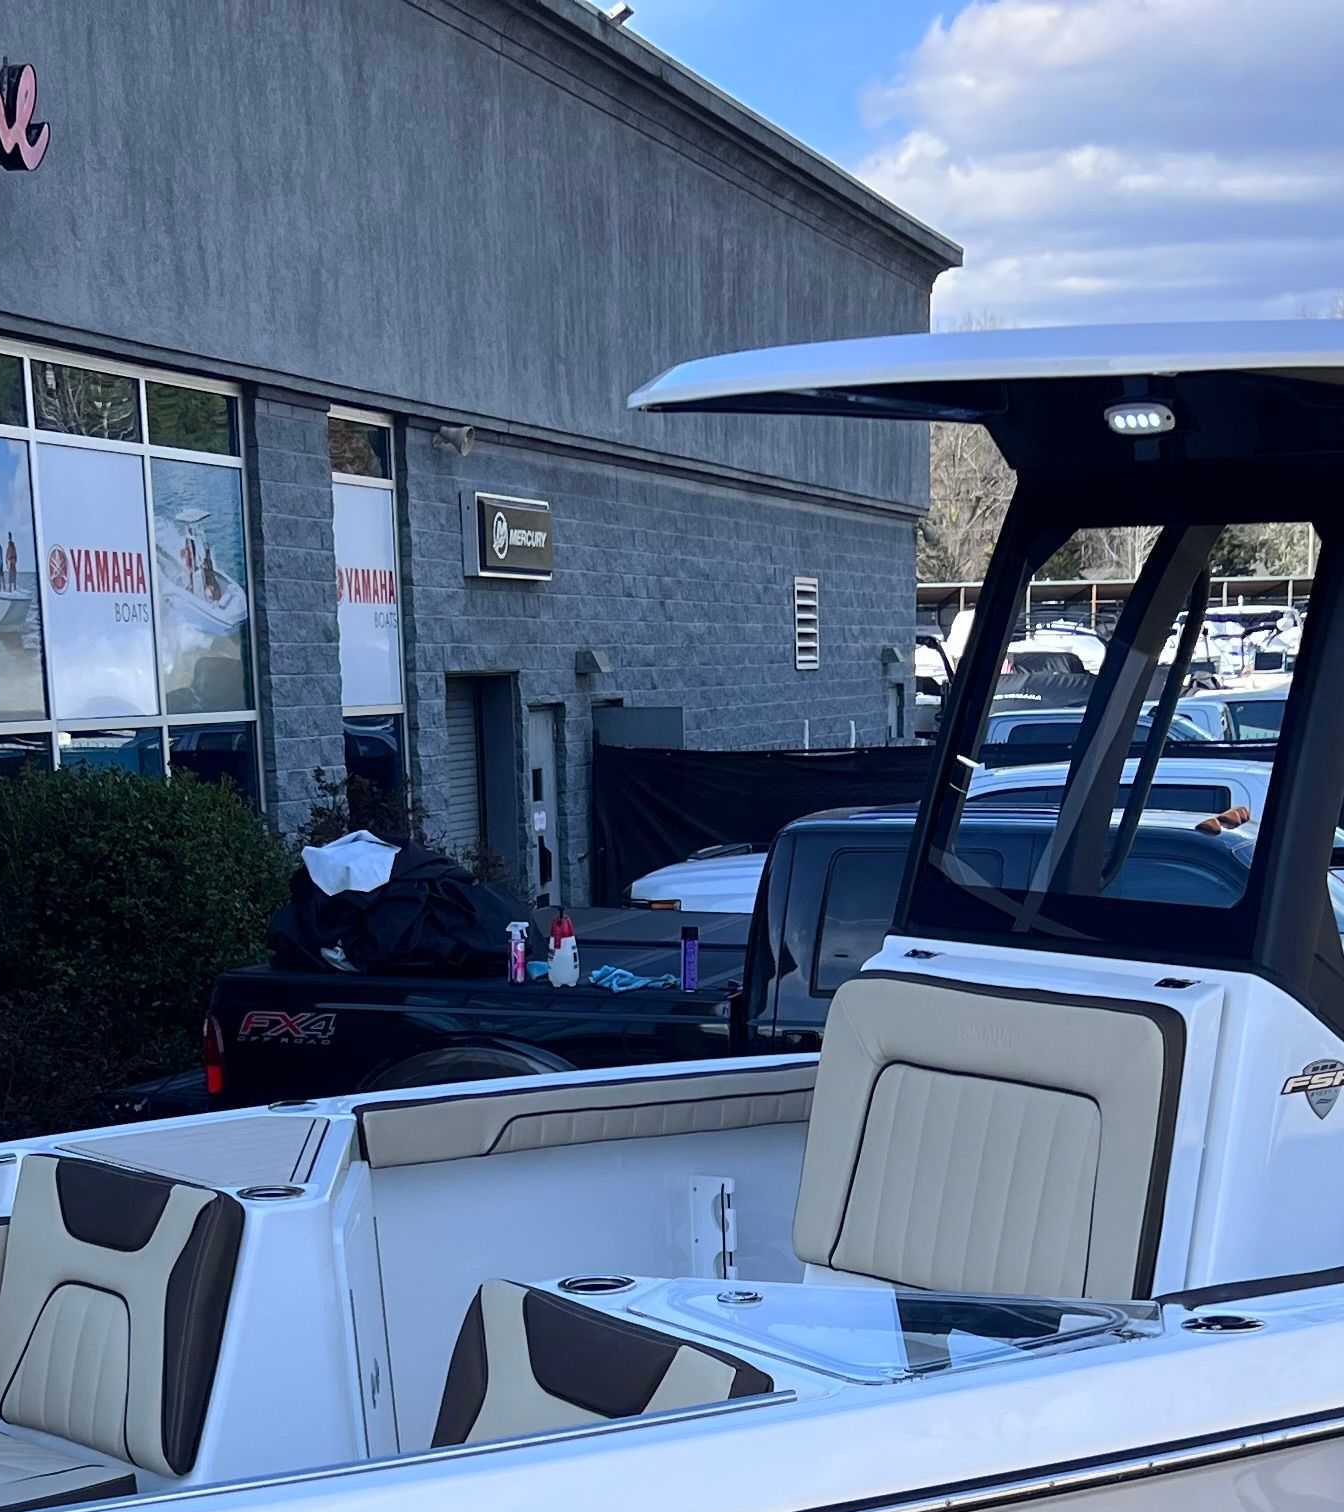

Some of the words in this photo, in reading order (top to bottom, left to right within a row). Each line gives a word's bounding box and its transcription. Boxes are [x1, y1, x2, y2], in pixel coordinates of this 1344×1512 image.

[509, 528, 547, 548] MERCURY
[69, 549, 147, 595] YAMAHA
[345, 568, 396, 604] YAMAHA
[114, 602, 150, 623] BOATS
[239, 1011, 336, 1038] FX4
